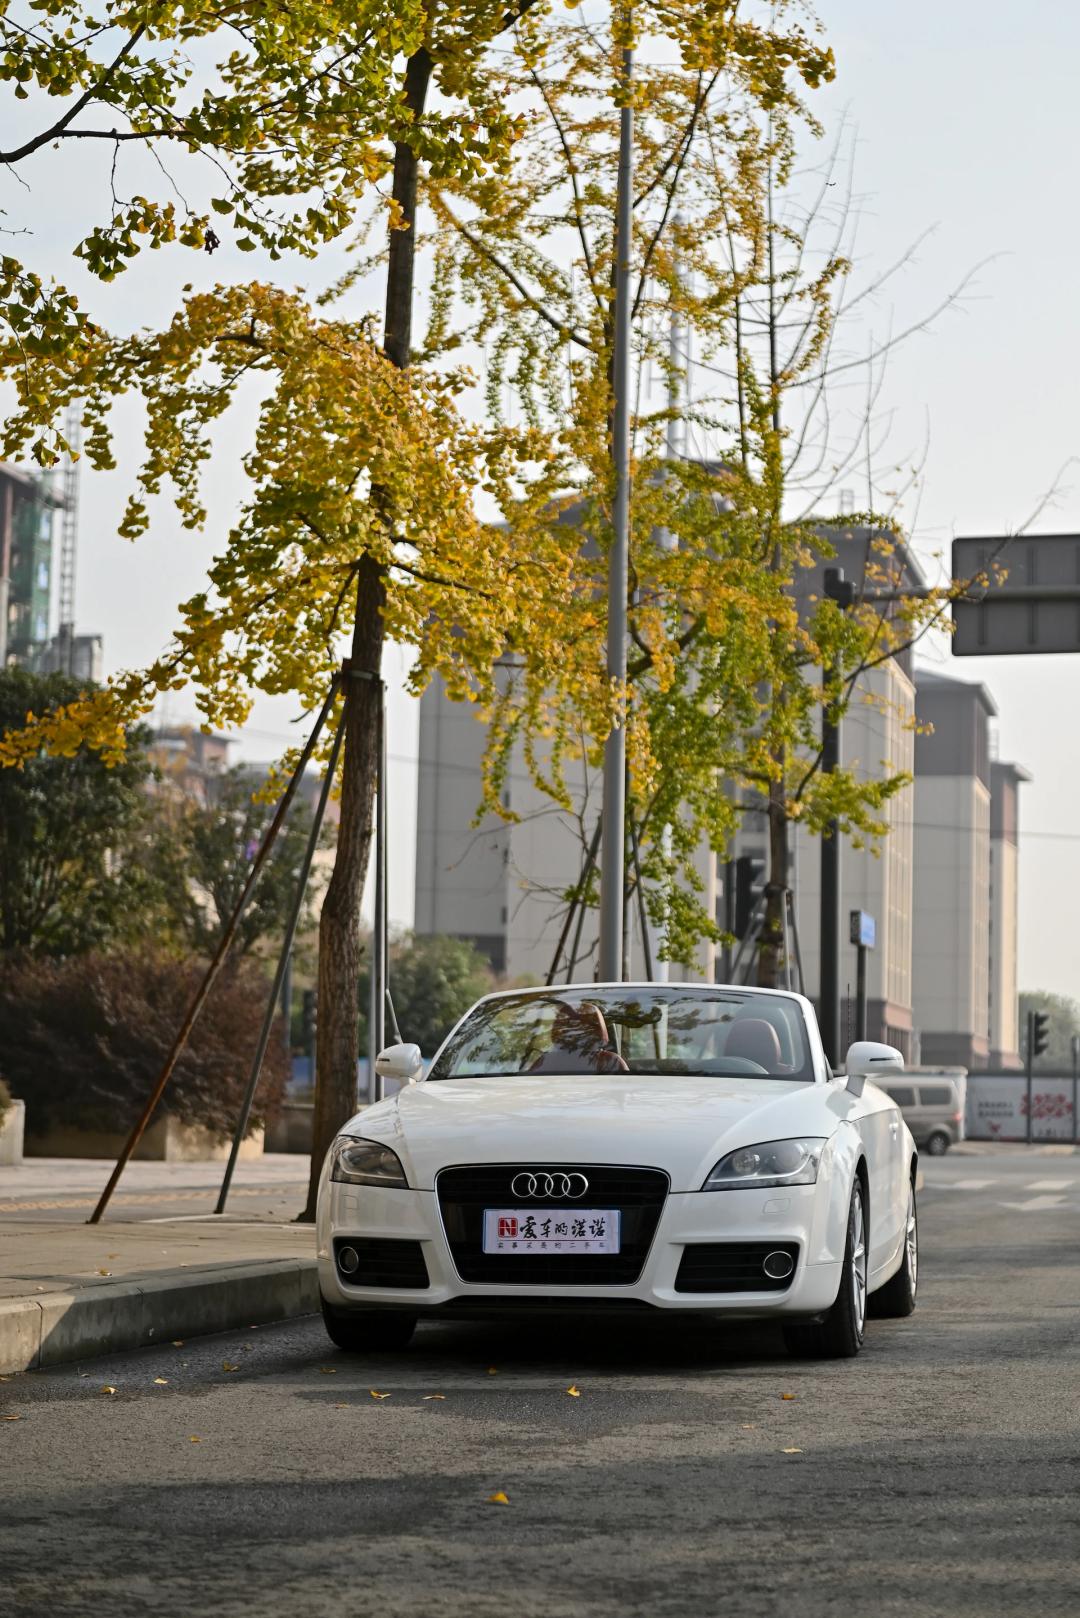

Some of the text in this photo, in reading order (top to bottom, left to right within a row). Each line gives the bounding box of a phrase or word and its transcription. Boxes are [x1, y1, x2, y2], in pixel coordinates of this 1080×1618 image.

[520, 1216, 605, 1239] 爱车的诺诺
